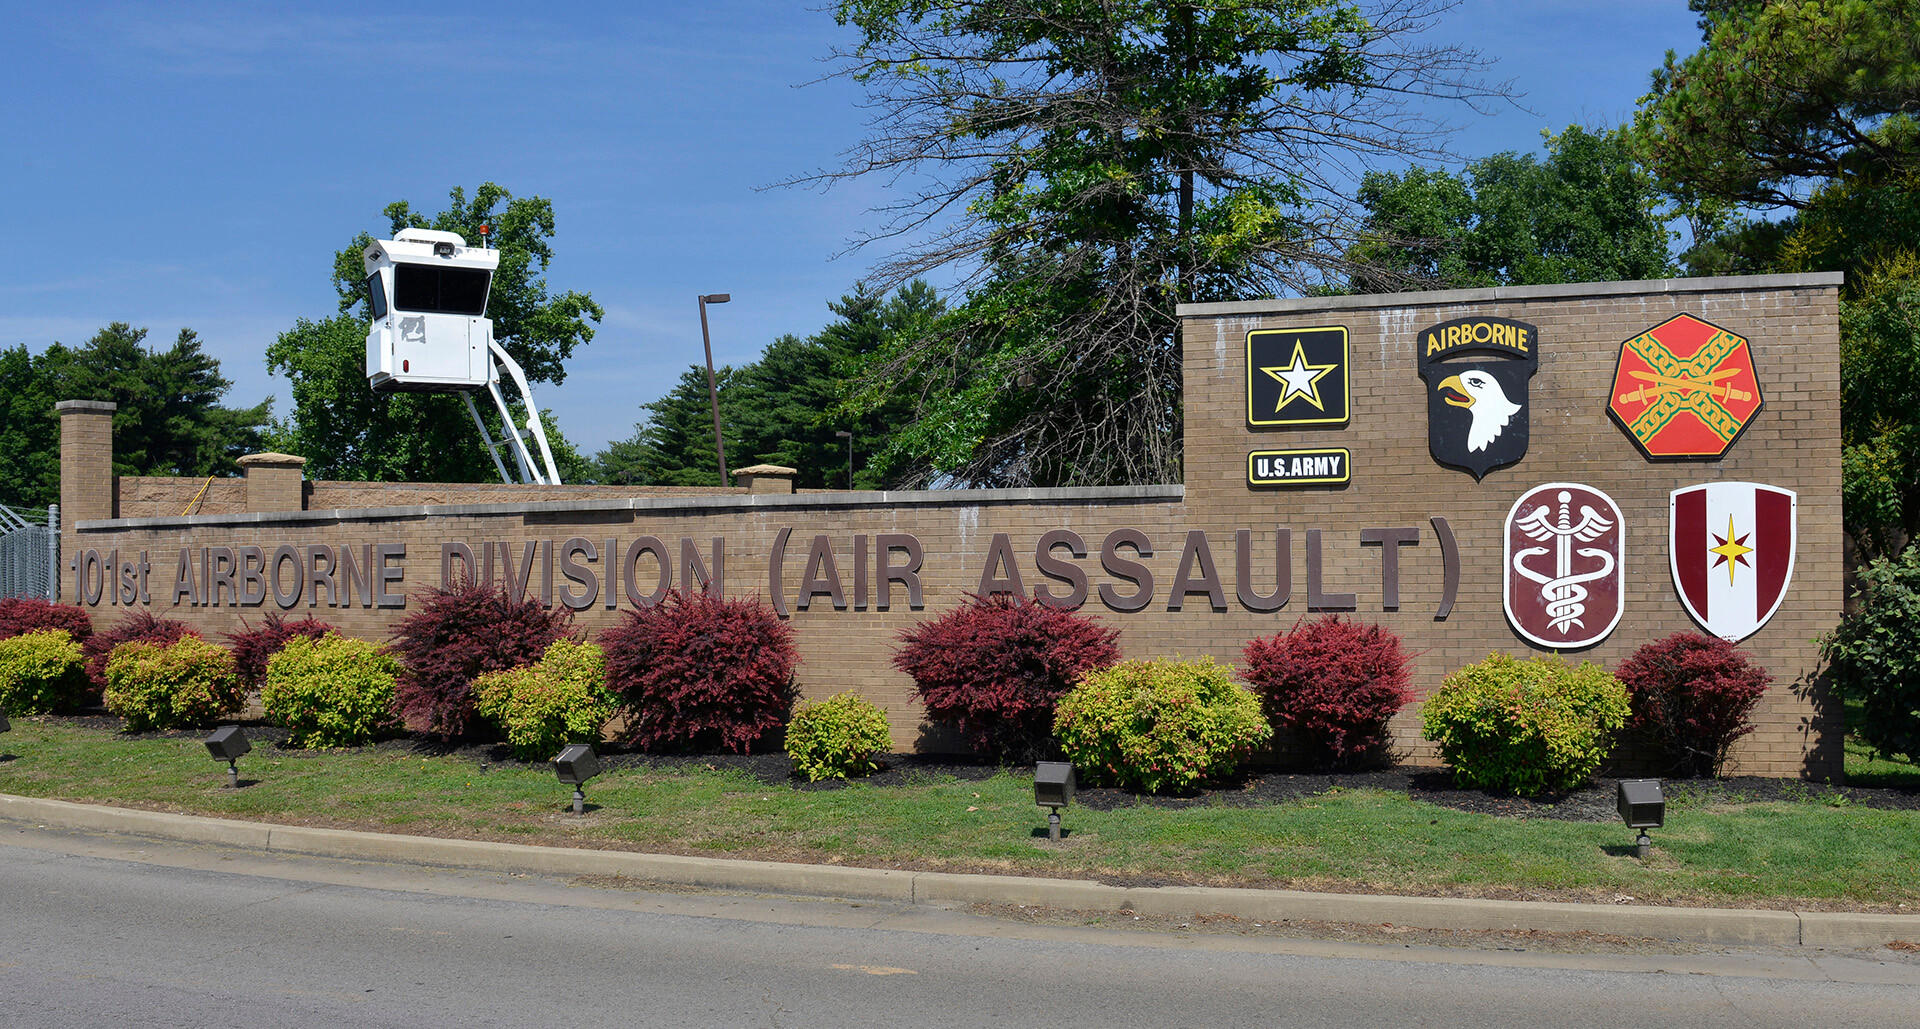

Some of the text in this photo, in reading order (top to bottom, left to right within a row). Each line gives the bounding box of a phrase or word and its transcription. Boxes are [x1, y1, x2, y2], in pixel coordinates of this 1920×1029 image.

[1426, 322, 1529, 357] AIRBORNE
[70, 515, 1462, 622] 101st AIRBORNE DIVISION (AIR ASSAULT)
